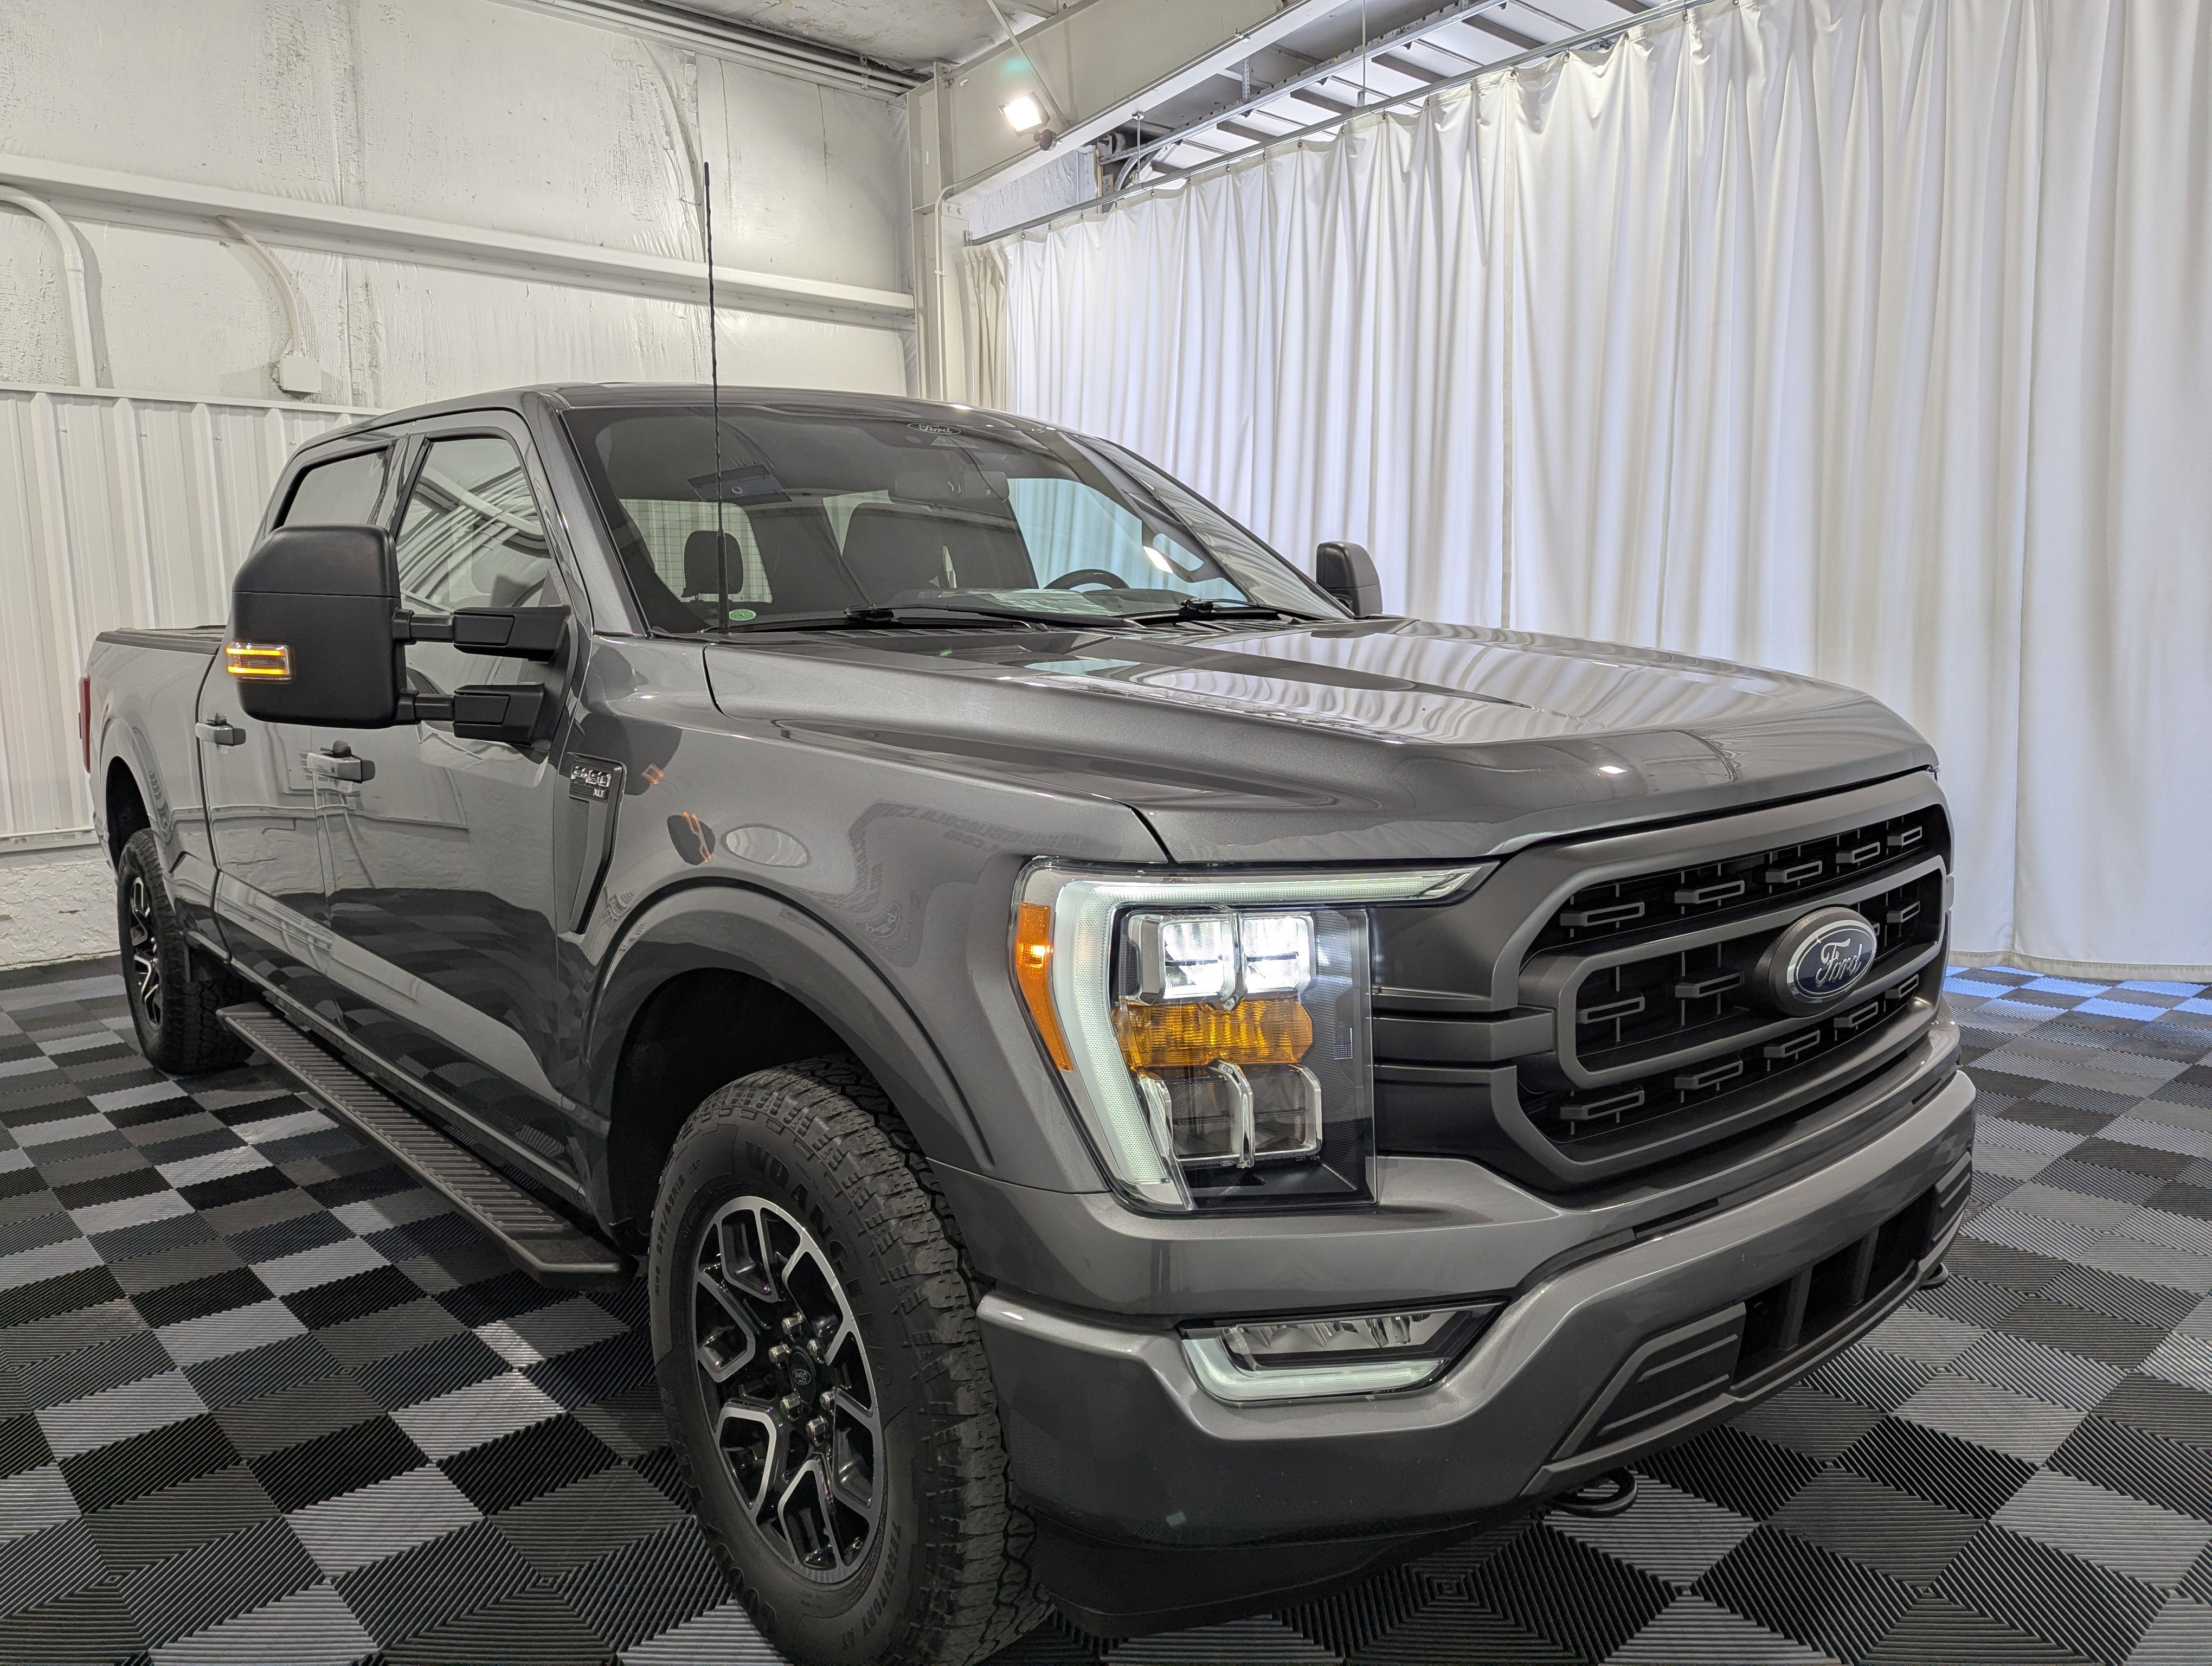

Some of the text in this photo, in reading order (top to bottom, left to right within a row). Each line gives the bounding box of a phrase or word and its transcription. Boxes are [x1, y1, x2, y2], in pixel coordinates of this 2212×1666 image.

[918, 424, 953, 433] Ford
[571, 766, 612, 787] F-150
[593, 788, 605, 798] XLT
[1815, 938, 1862, 988] Ford
